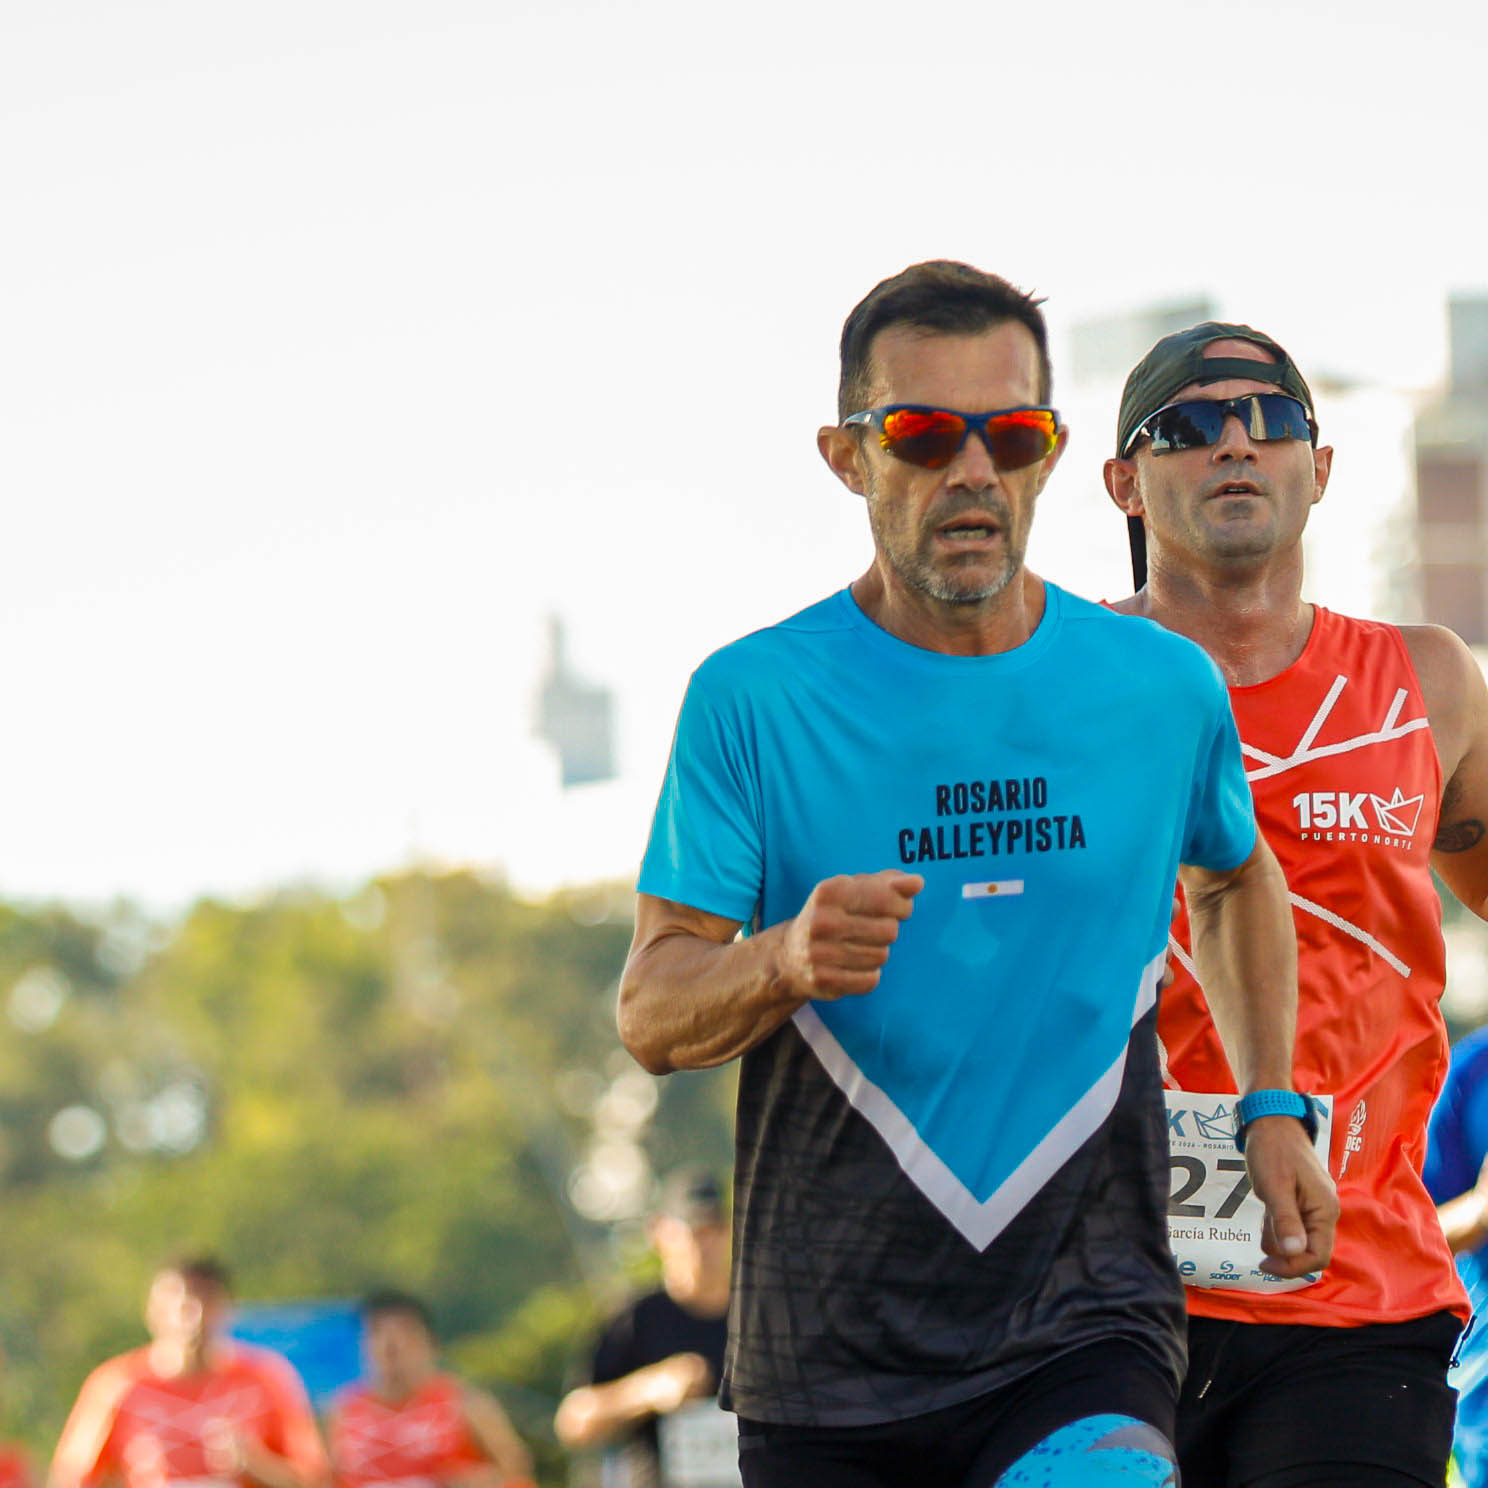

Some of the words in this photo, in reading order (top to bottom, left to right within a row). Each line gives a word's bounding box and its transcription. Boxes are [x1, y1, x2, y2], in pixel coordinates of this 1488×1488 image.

[936, 776, 1048, 817] ROSARIO
[1292, 792, 1369, 830] 15K
[898, 815, 1087, 864] CALLEYPISTA
[1209, 1227, 1251, 1242] Rubén
